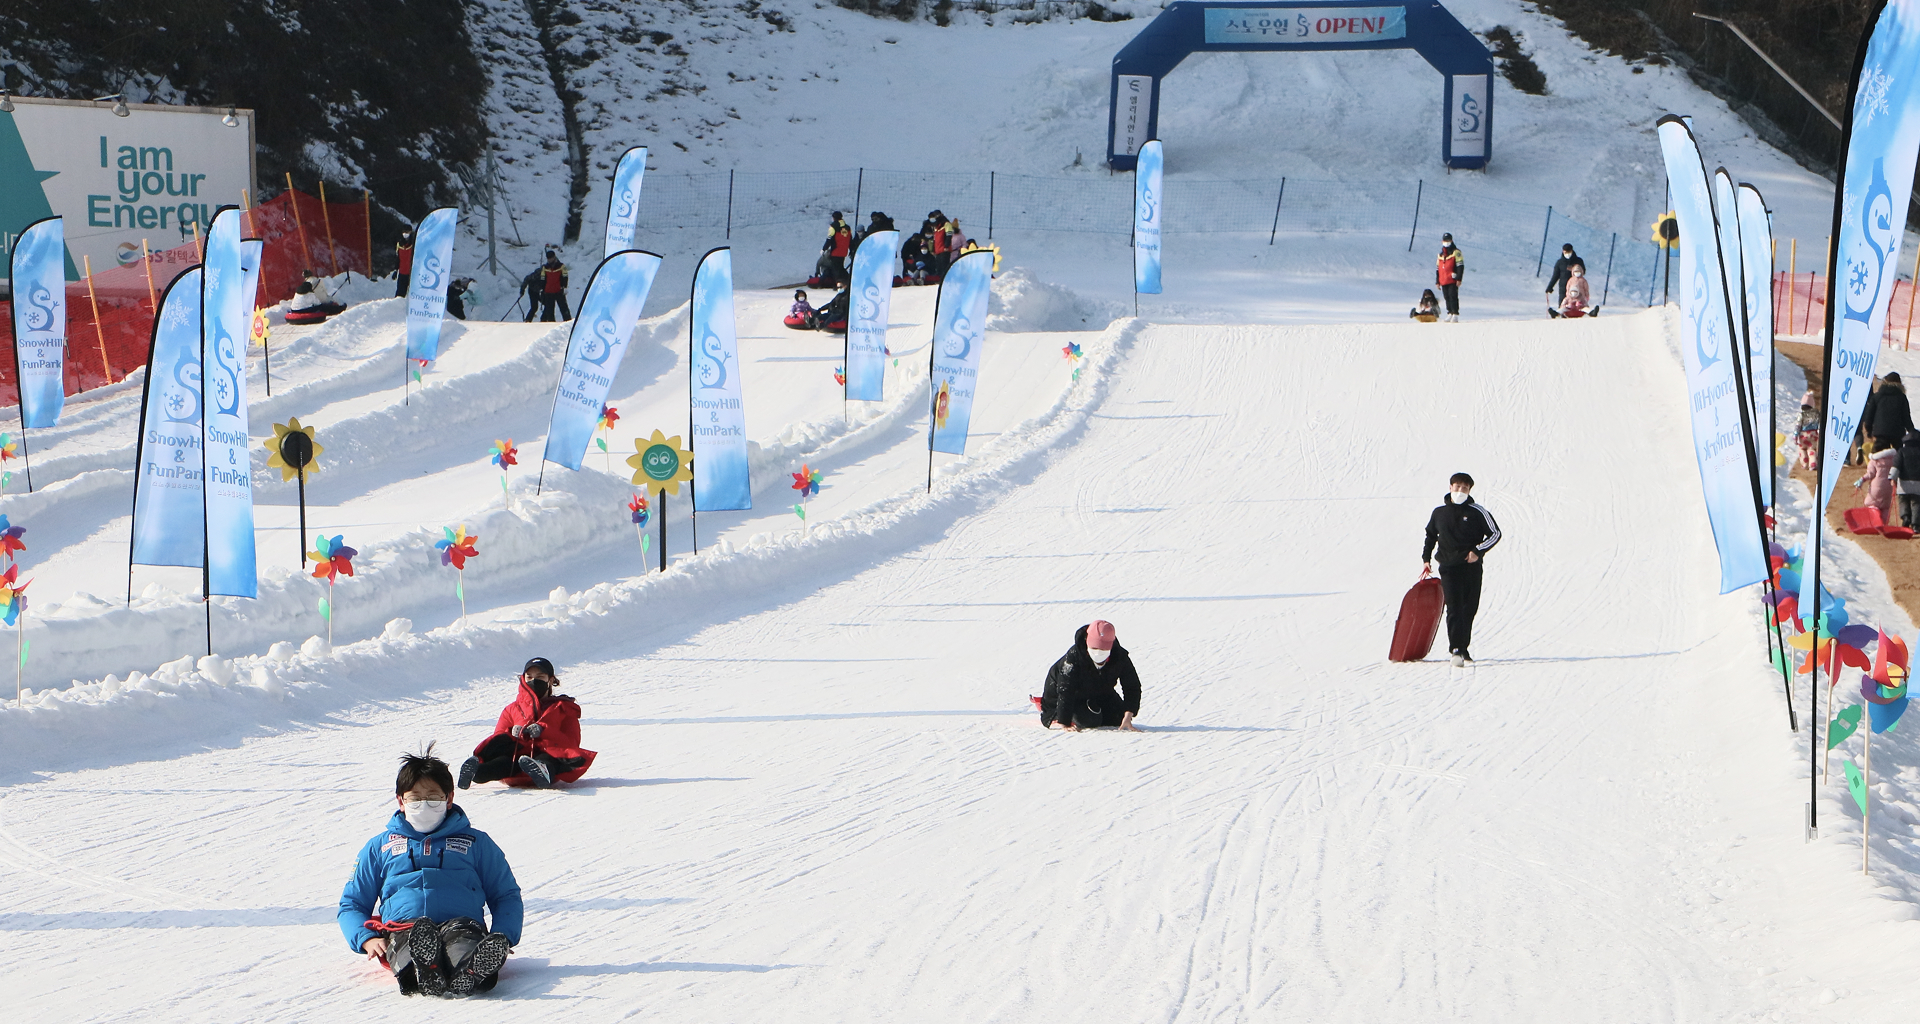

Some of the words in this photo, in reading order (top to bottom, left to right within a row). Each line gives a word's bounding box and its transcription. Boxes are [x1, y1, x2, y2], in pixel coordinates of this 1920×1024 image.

[1225, 19, 1289, 36] 스노우힐
[1316, 17, 1386, 34] OPEN!
[100, 136, 108, 168] I
[117, 145, 173, 171] am
[117, 170, 206, 203] your
[87, 194, 222, 235] Energy
[411, 292, 445, 304] SnowHill
[410, 308, 441, 319] FunPark
[19, 338, 62, 348] SnowHill
[37, 348, 44, 358] &
[22, 360, 62, 369] FunPark
[577, 380, 586, 391] &
[949, 375, 955, 385] &
[692, 396, 740, 409] SnowHill
[711, 411, 719, 423] &
[694, 424, 741, 436] FunPark
[208, 425, 248, 449] SnowHill
[174, 449, 185, 463] &
[229, 448, 236, 465] &
[211, 465, 249, 489] FunPark
